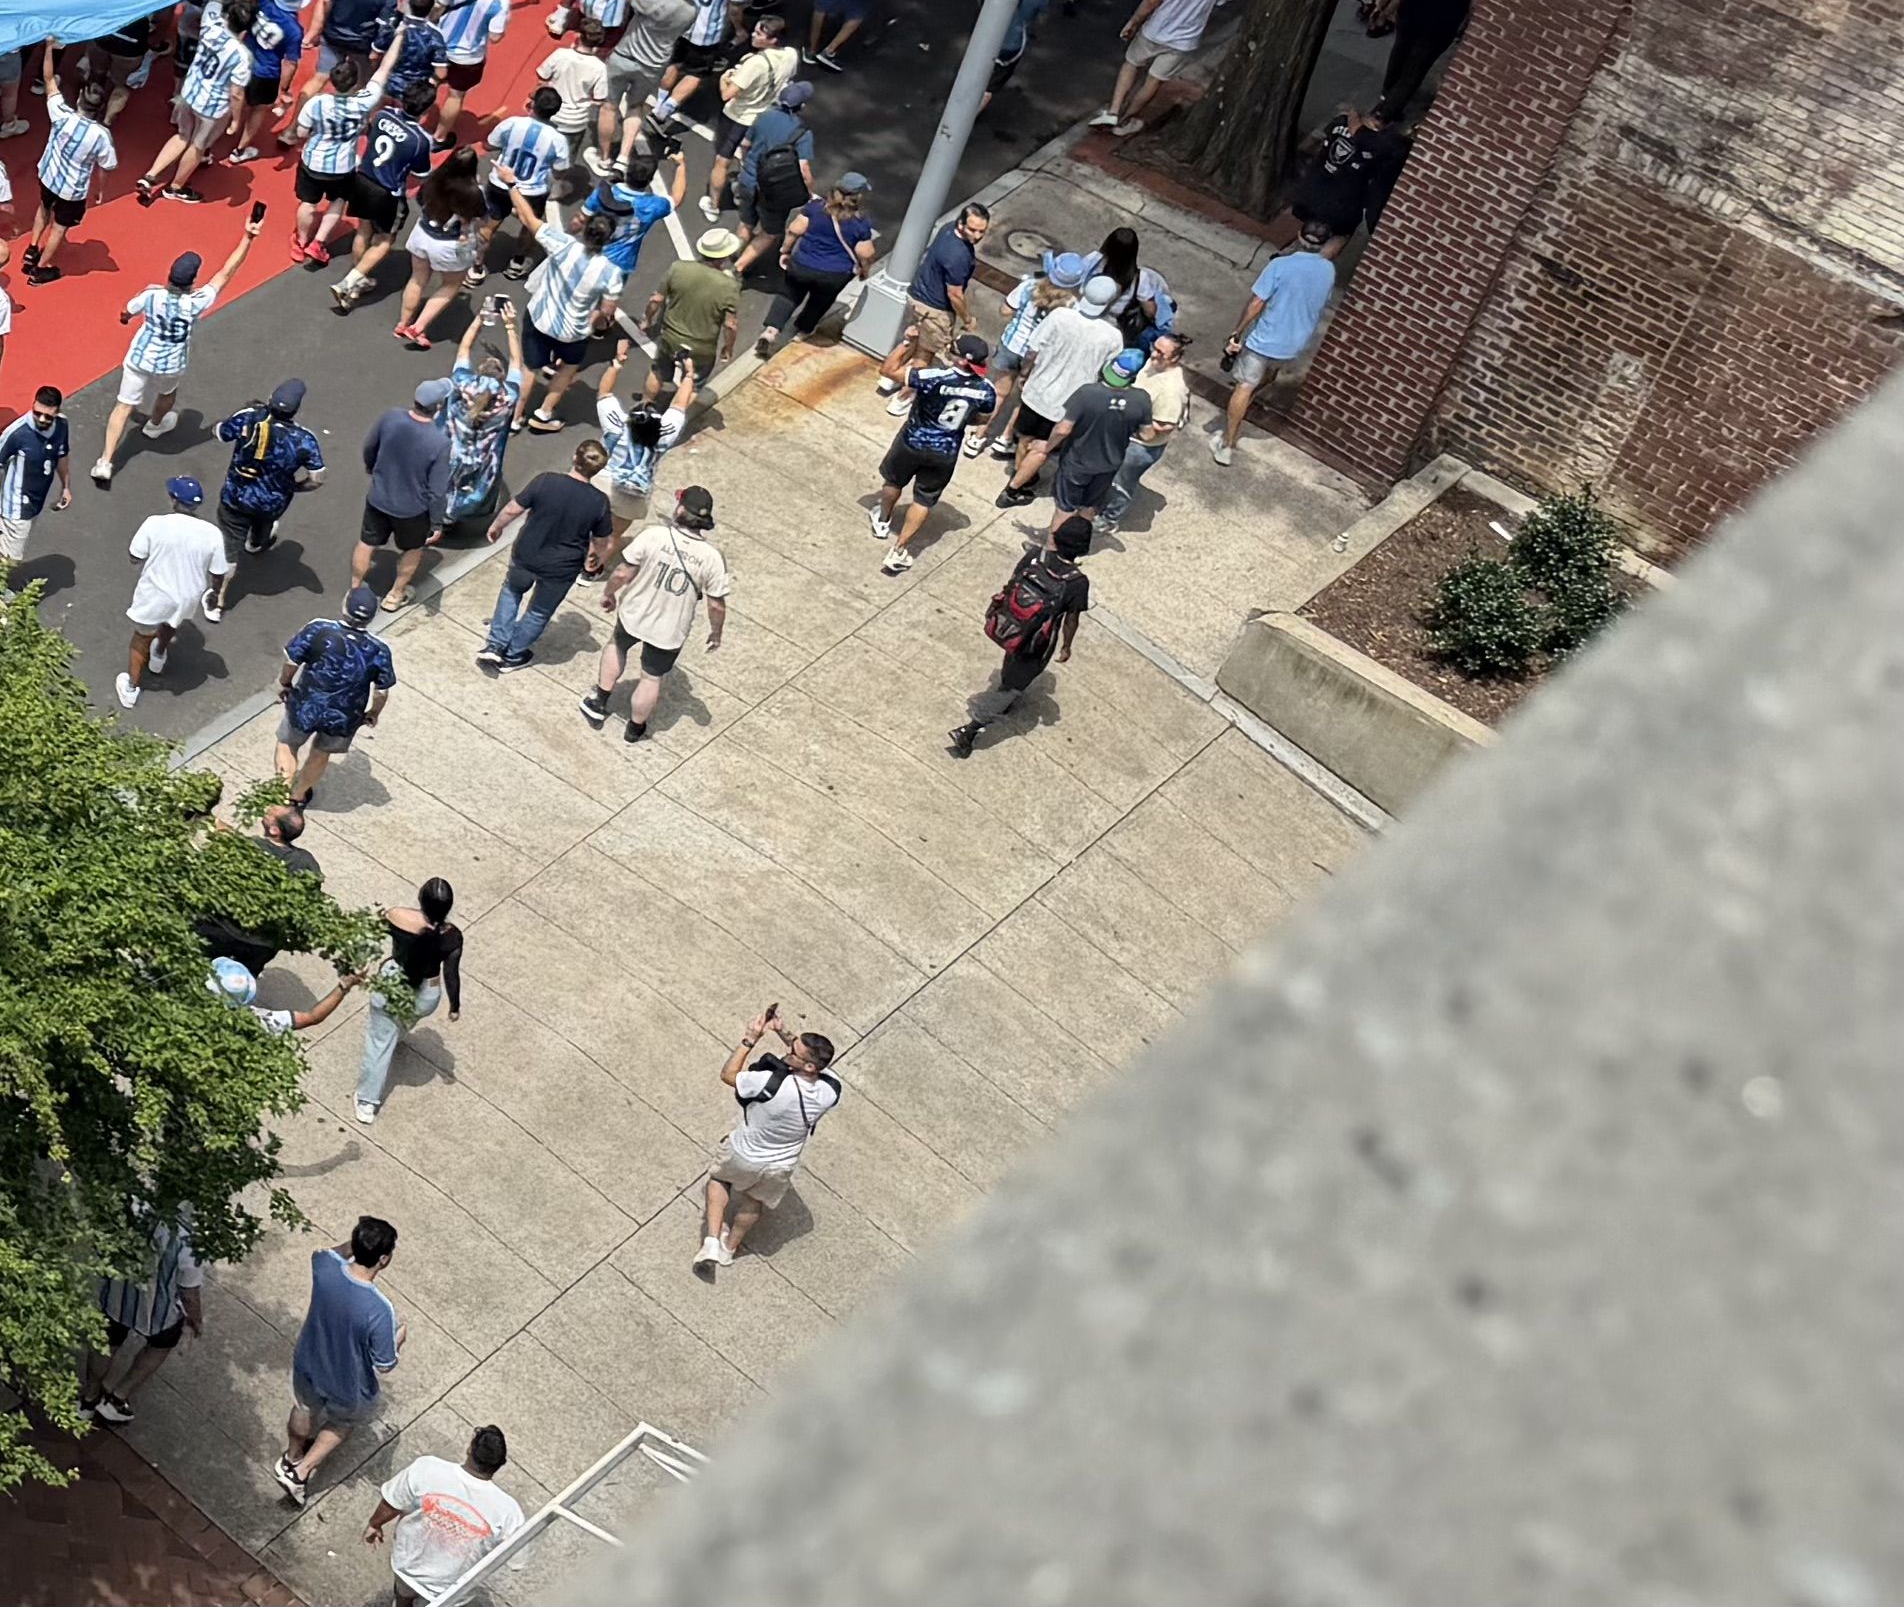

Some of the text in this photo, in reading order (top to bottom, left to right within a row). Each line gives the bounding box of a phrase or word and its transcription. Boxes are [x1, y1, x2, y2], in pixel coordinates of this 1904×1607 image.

[374, 136, 393, 167] 9
[509, 149, 537, 181] 10
[938, 399, 969, 430] 8
[653, 561, 689, 596] 10
